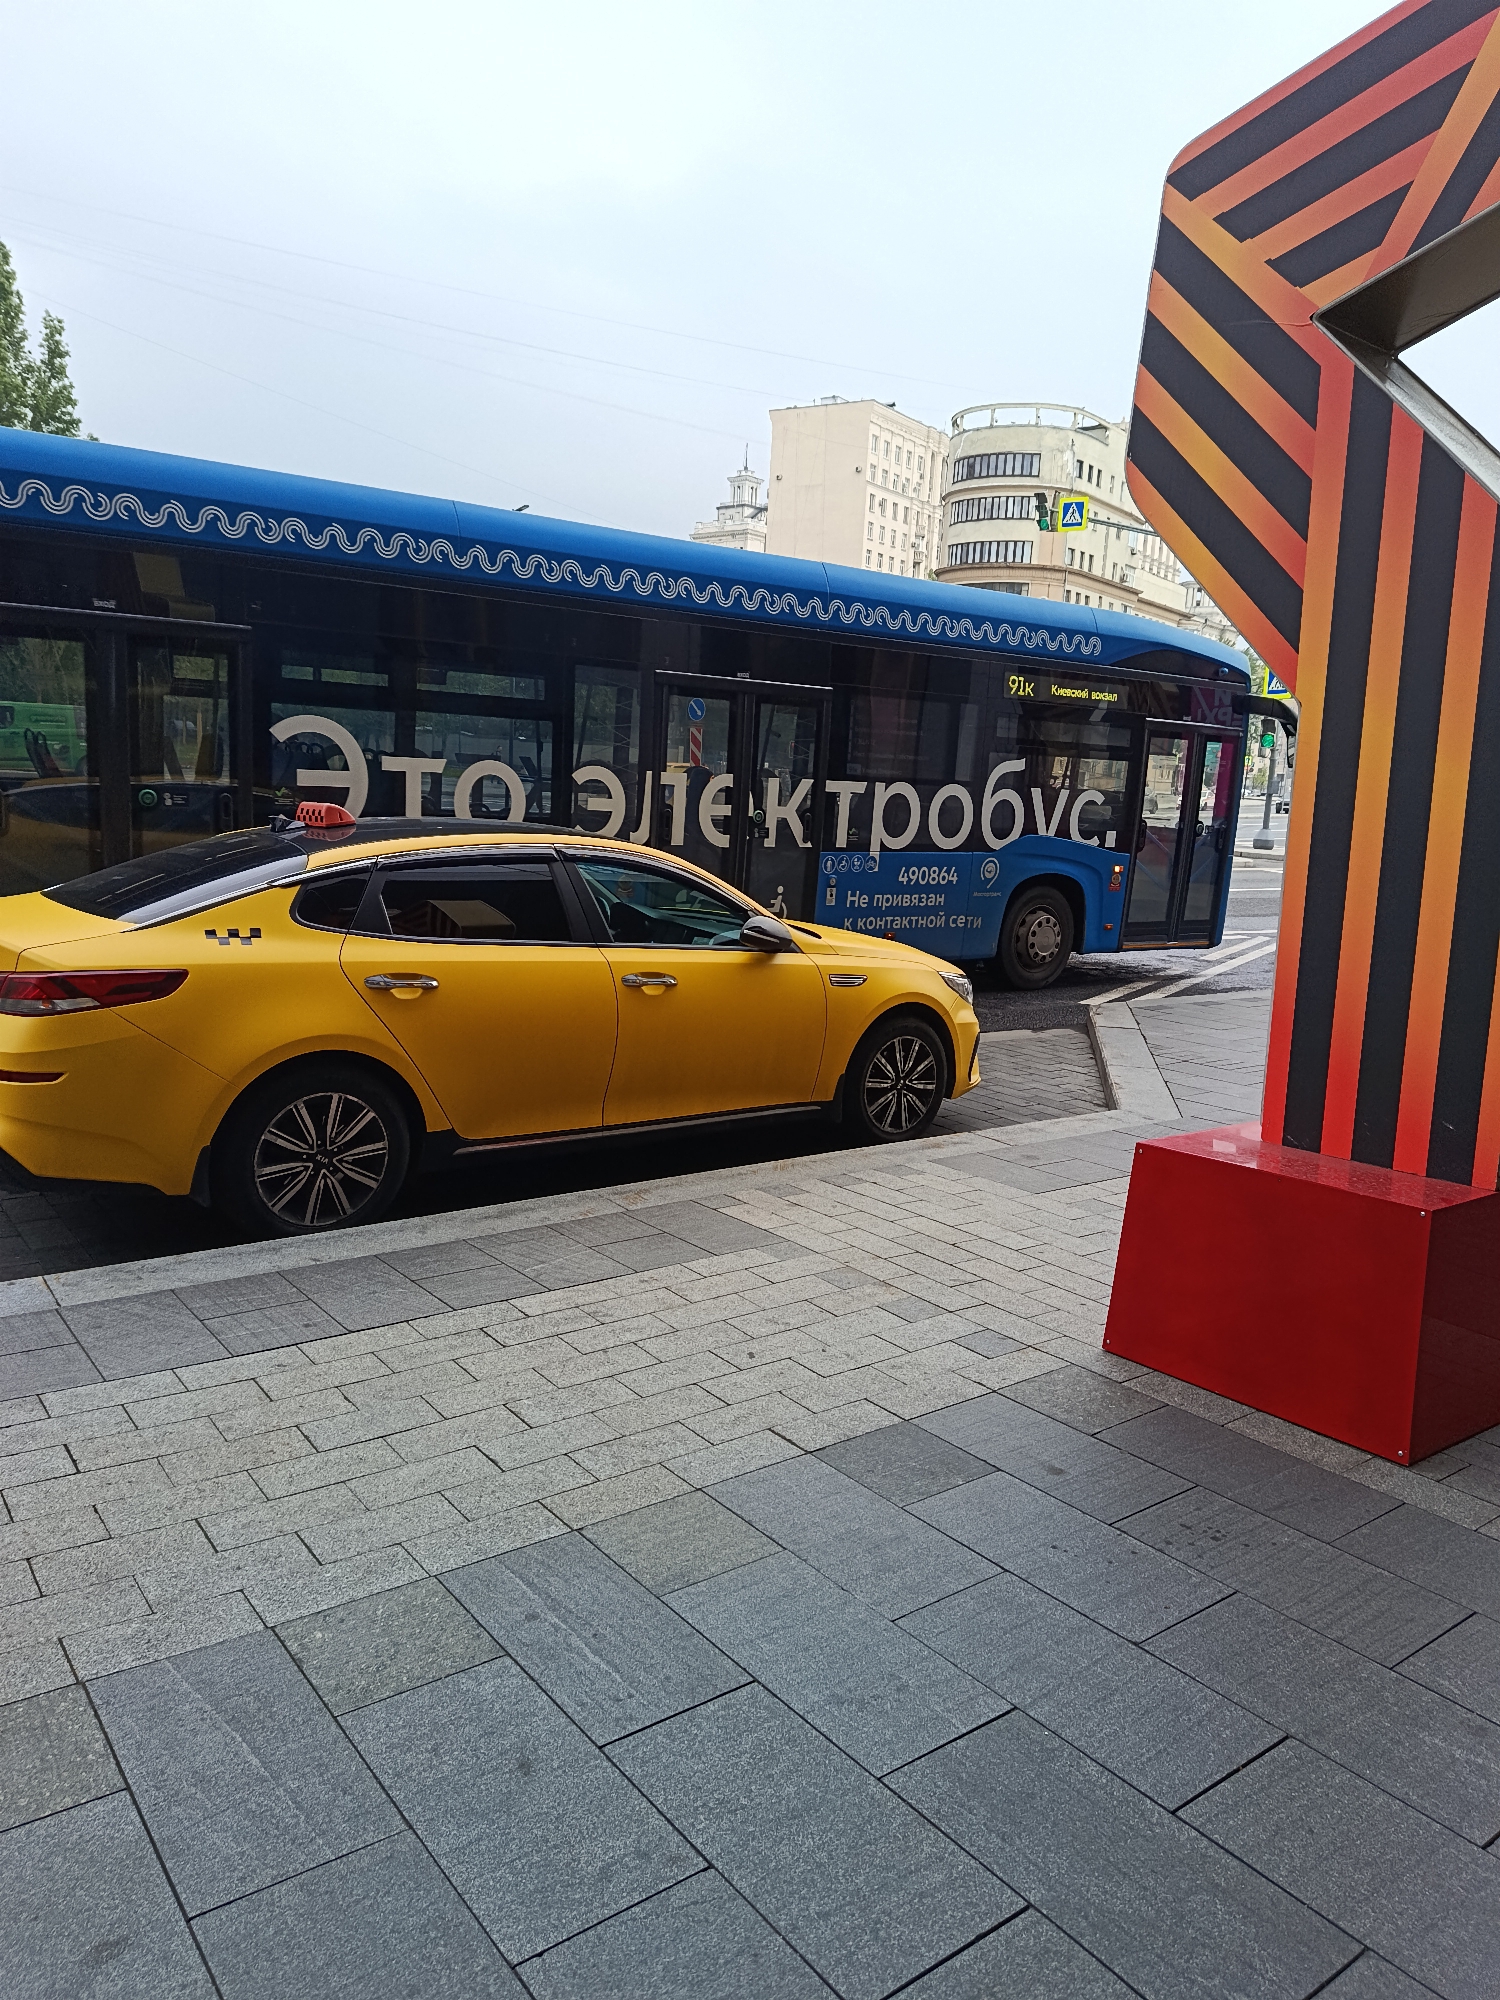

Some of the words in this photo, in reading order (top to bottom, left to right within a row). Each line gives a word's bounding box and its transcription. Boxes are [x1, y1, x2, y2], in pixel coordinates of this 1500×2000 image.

[1008, 675, 1035, 696] 91к
[1051, 684, 1089, 699] Киевский
[1091, 690, 1118, 702] вокзал
[269, 714, 527, 822] Это
[898, 866, 959, 885] 490864
[846, 890, 869, 908] Не
[873, 892, 945, 910] привязан
[843, 917, 853, 931] к
[857, 911, 945, 930] контактной
[949, 914, 983, 929] сети
